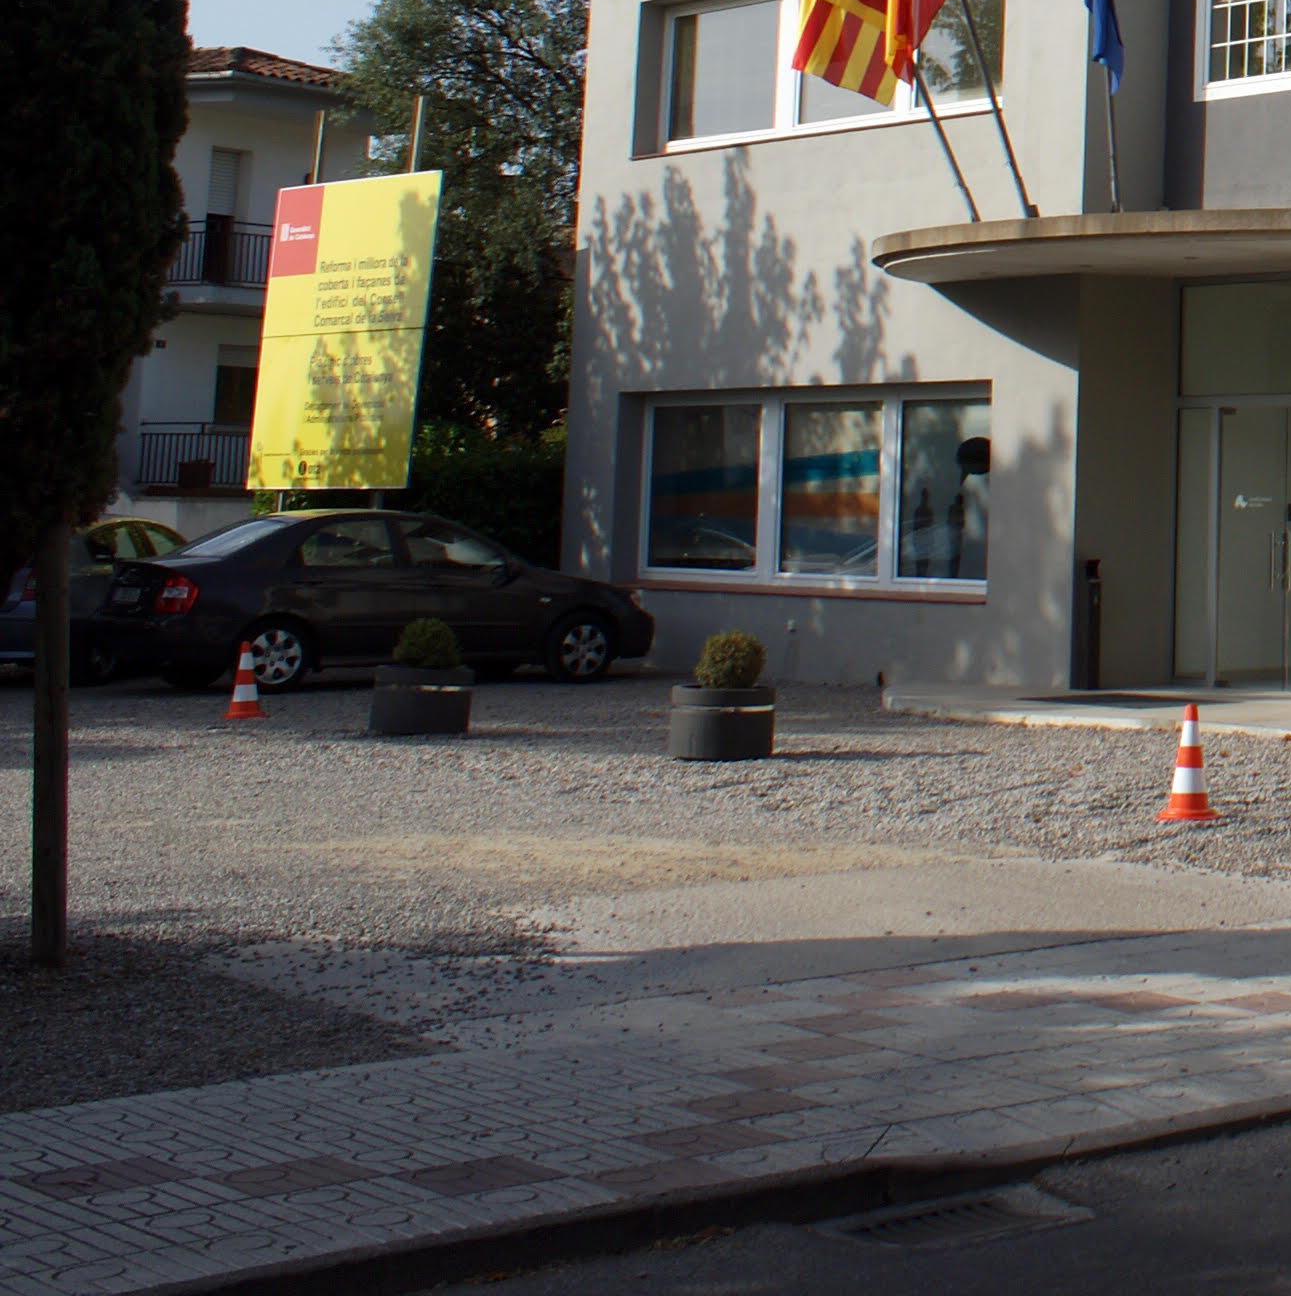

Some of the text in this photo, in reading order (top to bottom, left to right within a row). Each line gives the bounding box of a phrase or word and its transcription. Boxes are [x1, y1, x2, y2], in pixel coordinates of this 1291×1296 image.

[320, 261, 352, 272] Reforma
[358, 257, 386, 270] millora
[318, 280, 349, 291] coberta
[314, 313, 352, 327] Comarcal
